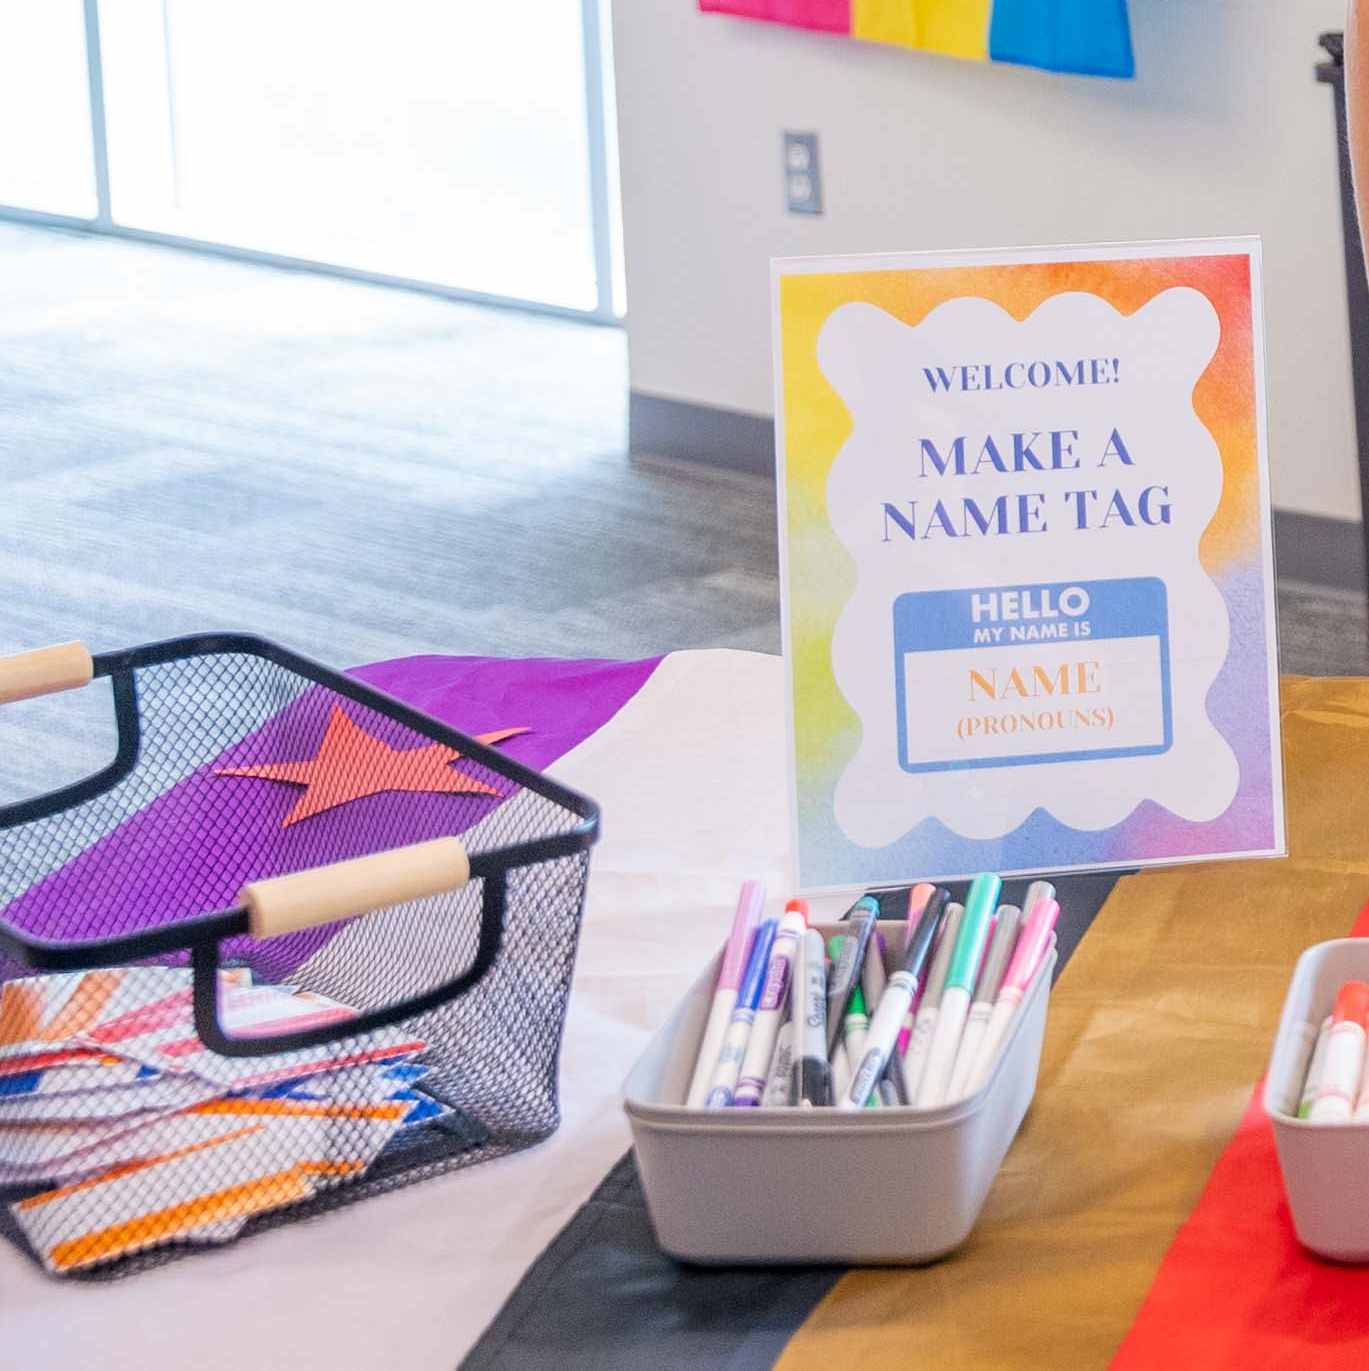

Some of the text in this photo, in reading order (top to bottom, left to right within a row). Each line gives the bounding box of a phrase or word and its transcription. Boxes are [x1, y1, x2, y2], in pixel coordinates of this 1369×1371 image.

[922, 358, 1121, 393] WELCOME!
[919, 428, 1135, 478] MAKE A
[881, 486, 1173, 542] NAME TAG
[971, 587, 1090, 621] HELLO
[973, 621, 1091, 644] MY NAME IS
[967, 661, 1102, 702] NAME
[956, 708, 1115, 740] (PRONOUNS)
